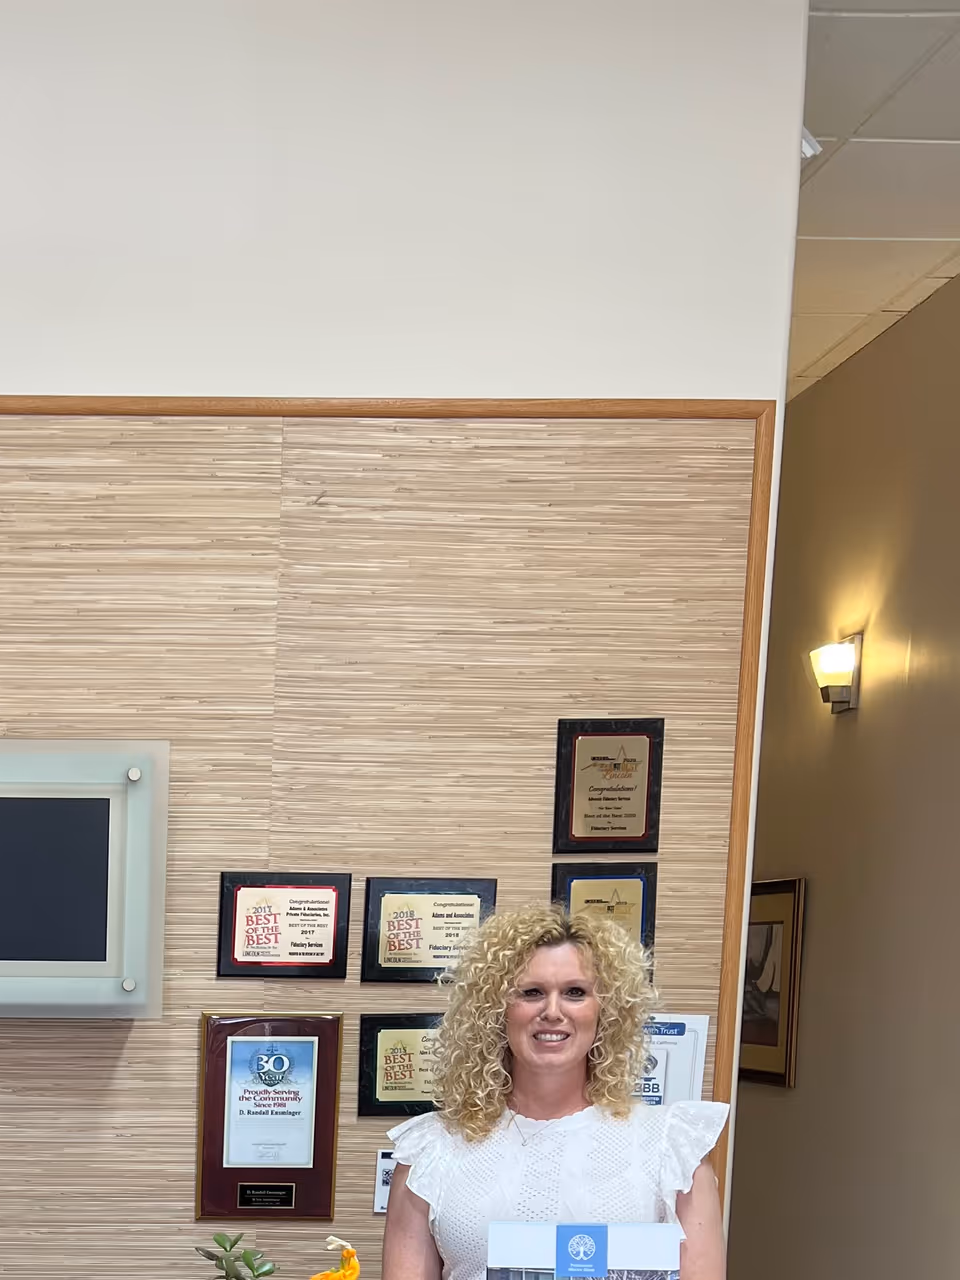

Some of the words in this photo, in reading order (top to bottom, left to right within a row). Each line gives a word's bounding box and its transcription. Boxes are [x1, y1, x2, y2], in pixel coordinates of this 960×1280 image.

[589, 784, 637, 795] Congratulations!
[252, 906, 272, 914] 2017
[393, 911, 414, 919] 2018
[246, 913, 280, 926] BEST
[387, 918, 422, 932] BEST
[246, 933, 281, 946] BEST
[387, 938, 423, 952] BEST
[257, 1055, 290, 1073] 30
[384, 1053, 414, 1065] BEST
[385, 1069, 415, 1081] BEST
